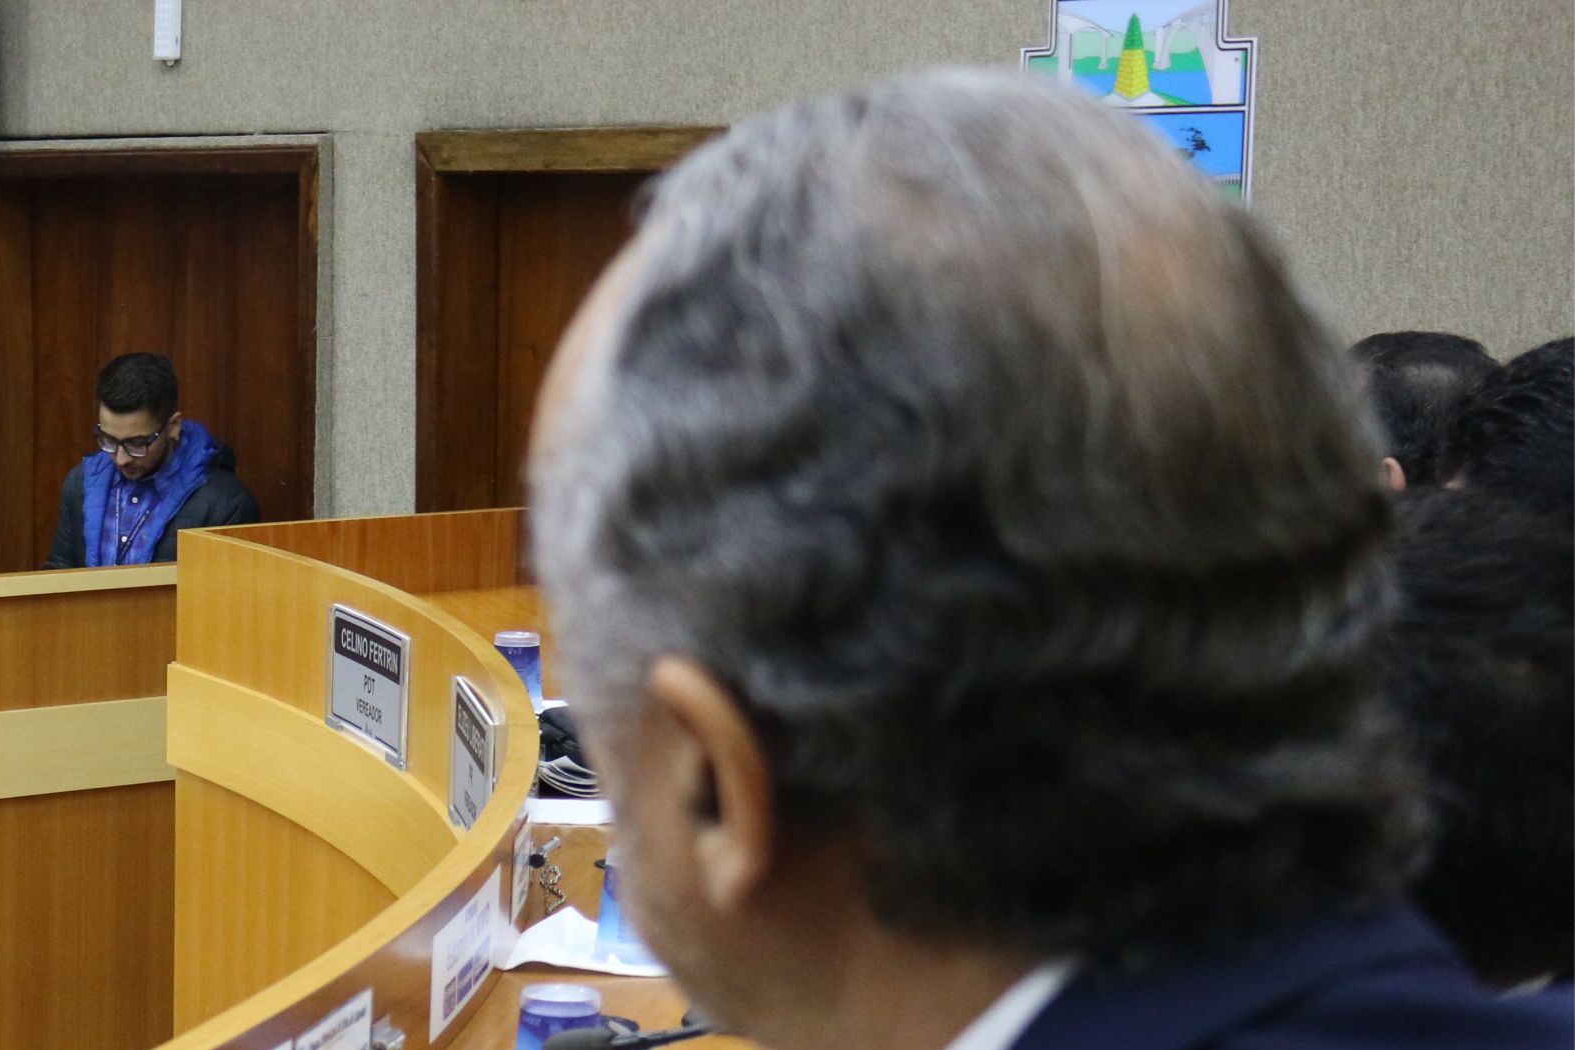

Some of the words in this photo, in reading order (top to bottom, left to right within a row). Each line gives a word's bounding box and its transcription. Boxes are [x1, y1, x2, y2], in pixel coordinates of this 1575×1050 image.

[341, 627, 368, 658] CELINO
[368, 640, 399, 674] FERTRIN
[364, 674, 375, 696] PDT
[356, 697, 382, 723] VEREADOR
